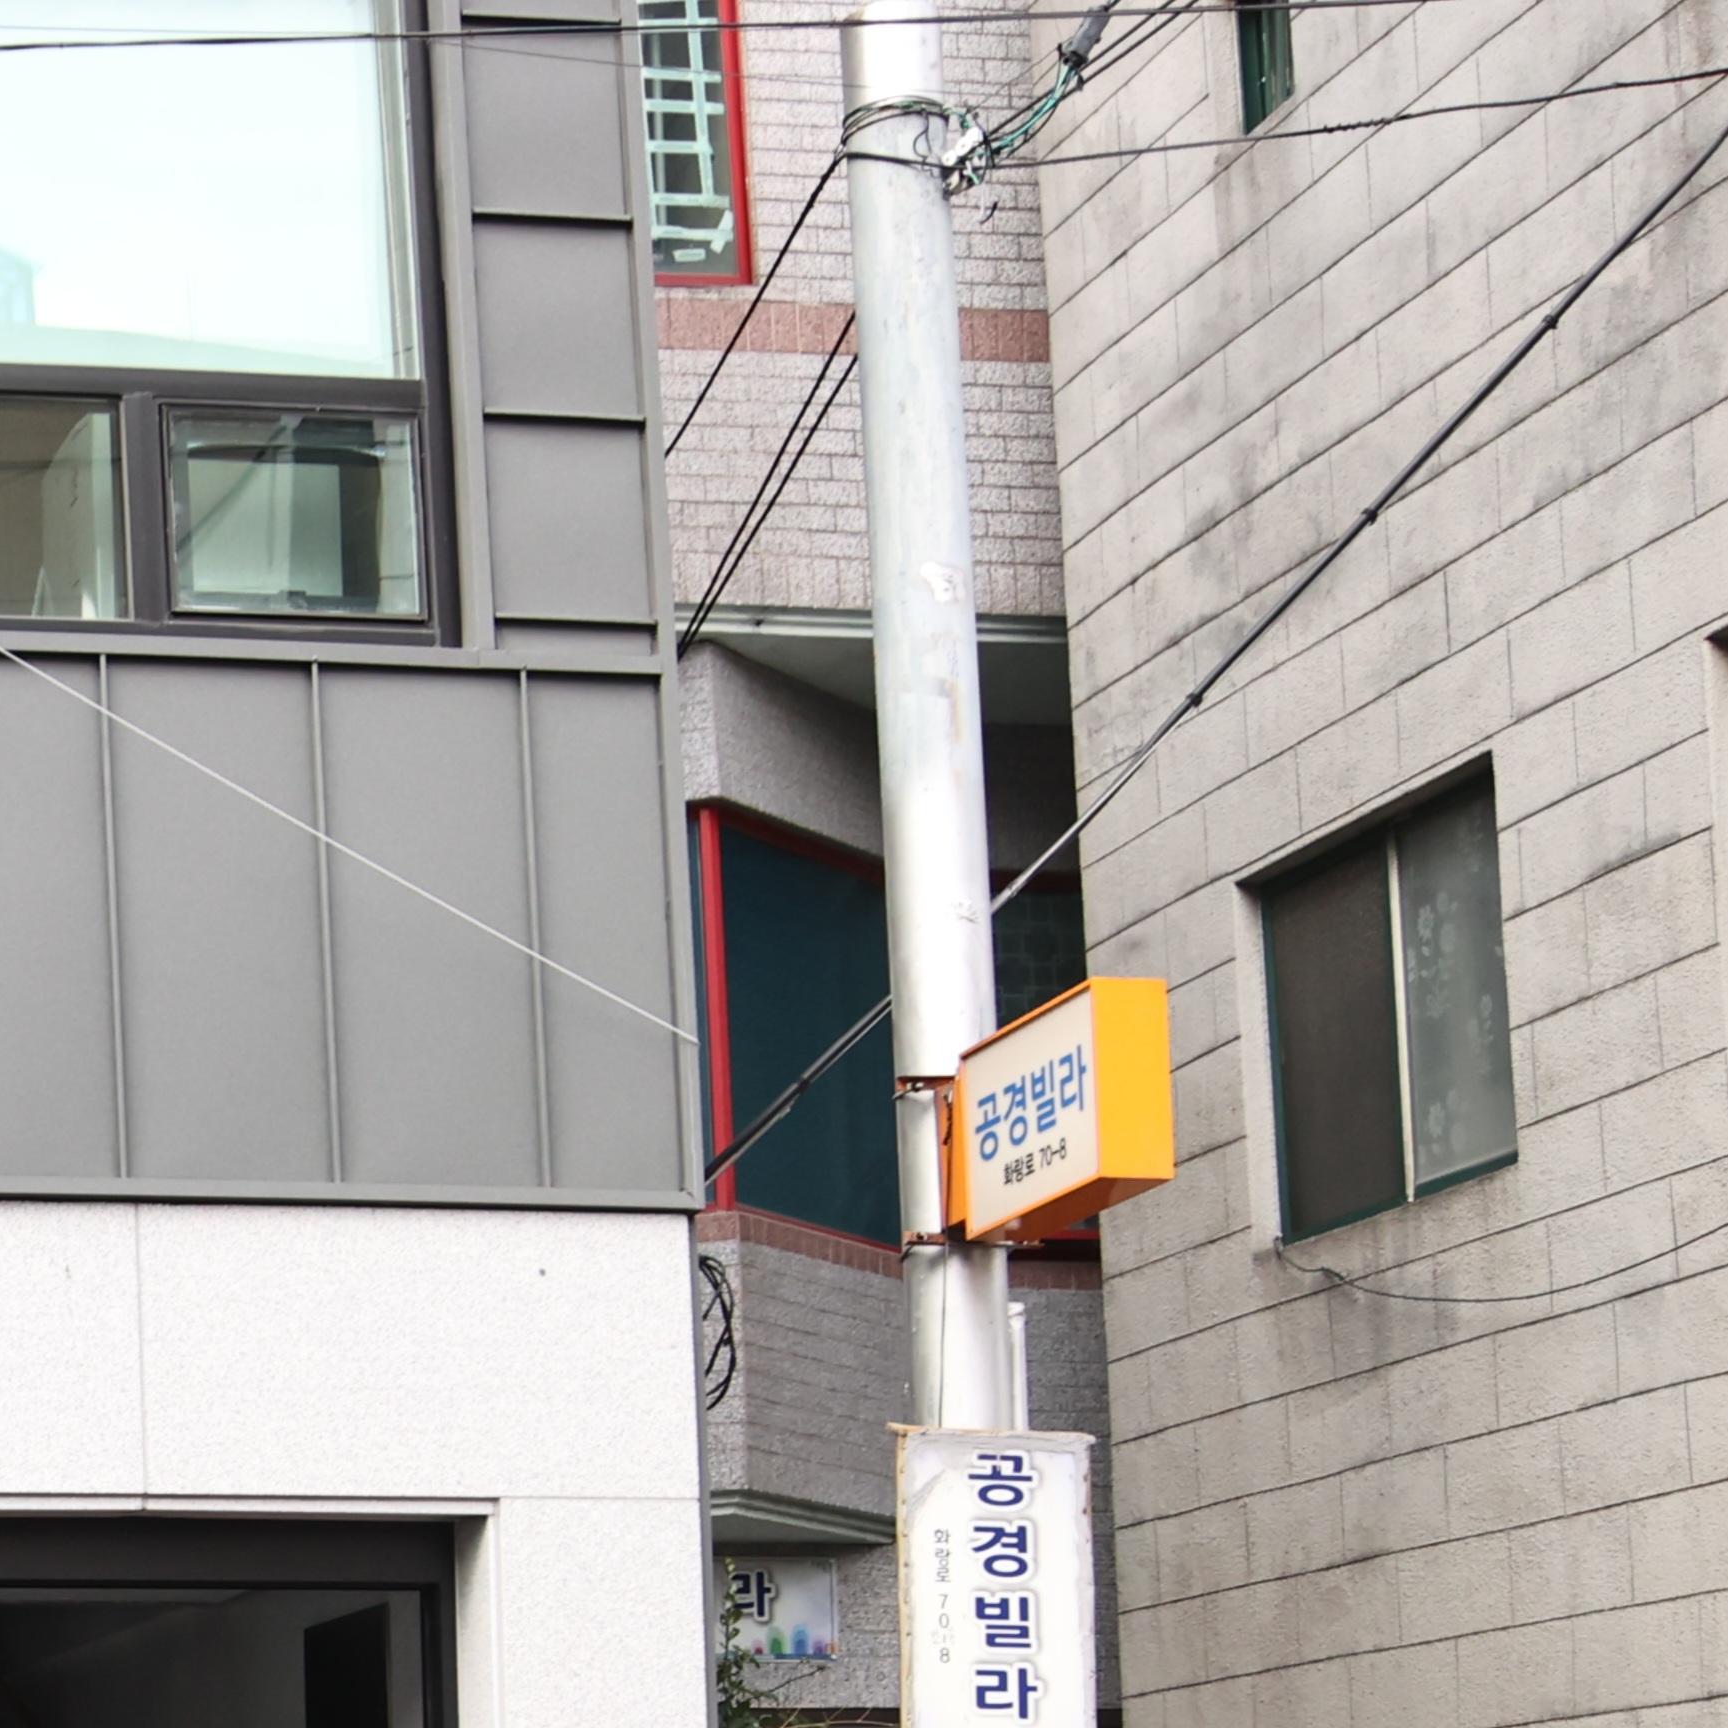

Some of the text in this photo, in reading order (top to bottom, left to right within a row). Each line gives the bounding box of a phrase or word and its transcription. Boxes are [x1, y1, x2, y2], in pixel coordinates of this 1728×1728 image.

[975, 1044, 1087, 1162] 공경빌라
[1003, 1137, 1067, 1186] 화랑로 70-8
[968, 1454, 1038, 1720] 공경빌라
